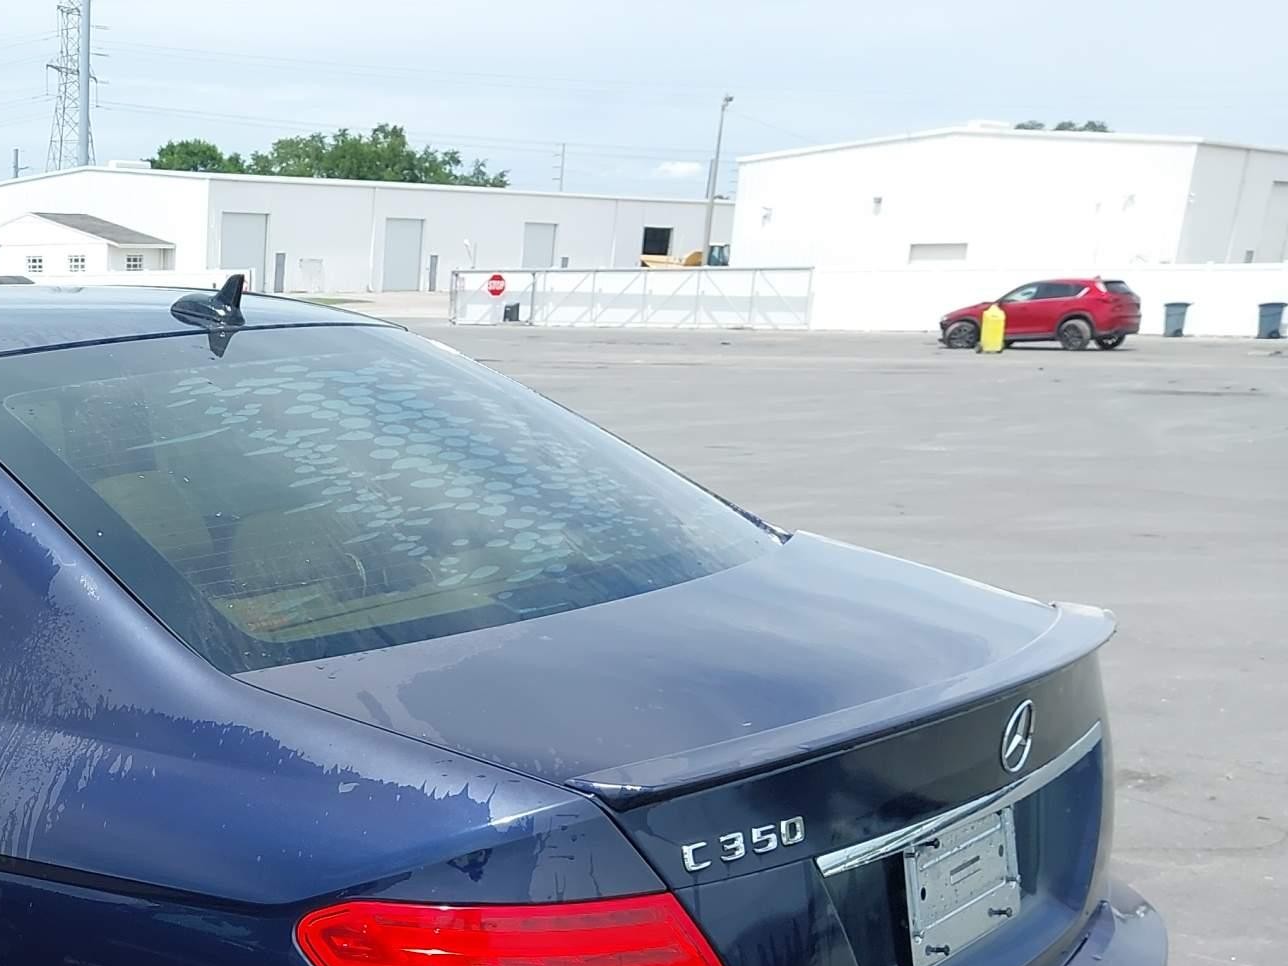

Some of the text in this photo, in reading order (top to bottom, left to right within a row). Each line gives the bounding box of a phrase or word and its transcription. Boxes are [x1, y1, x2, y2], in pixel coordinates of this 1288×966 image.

[488, 280, 505, 290] STOP
[681, 815, 805, 872] C 350
